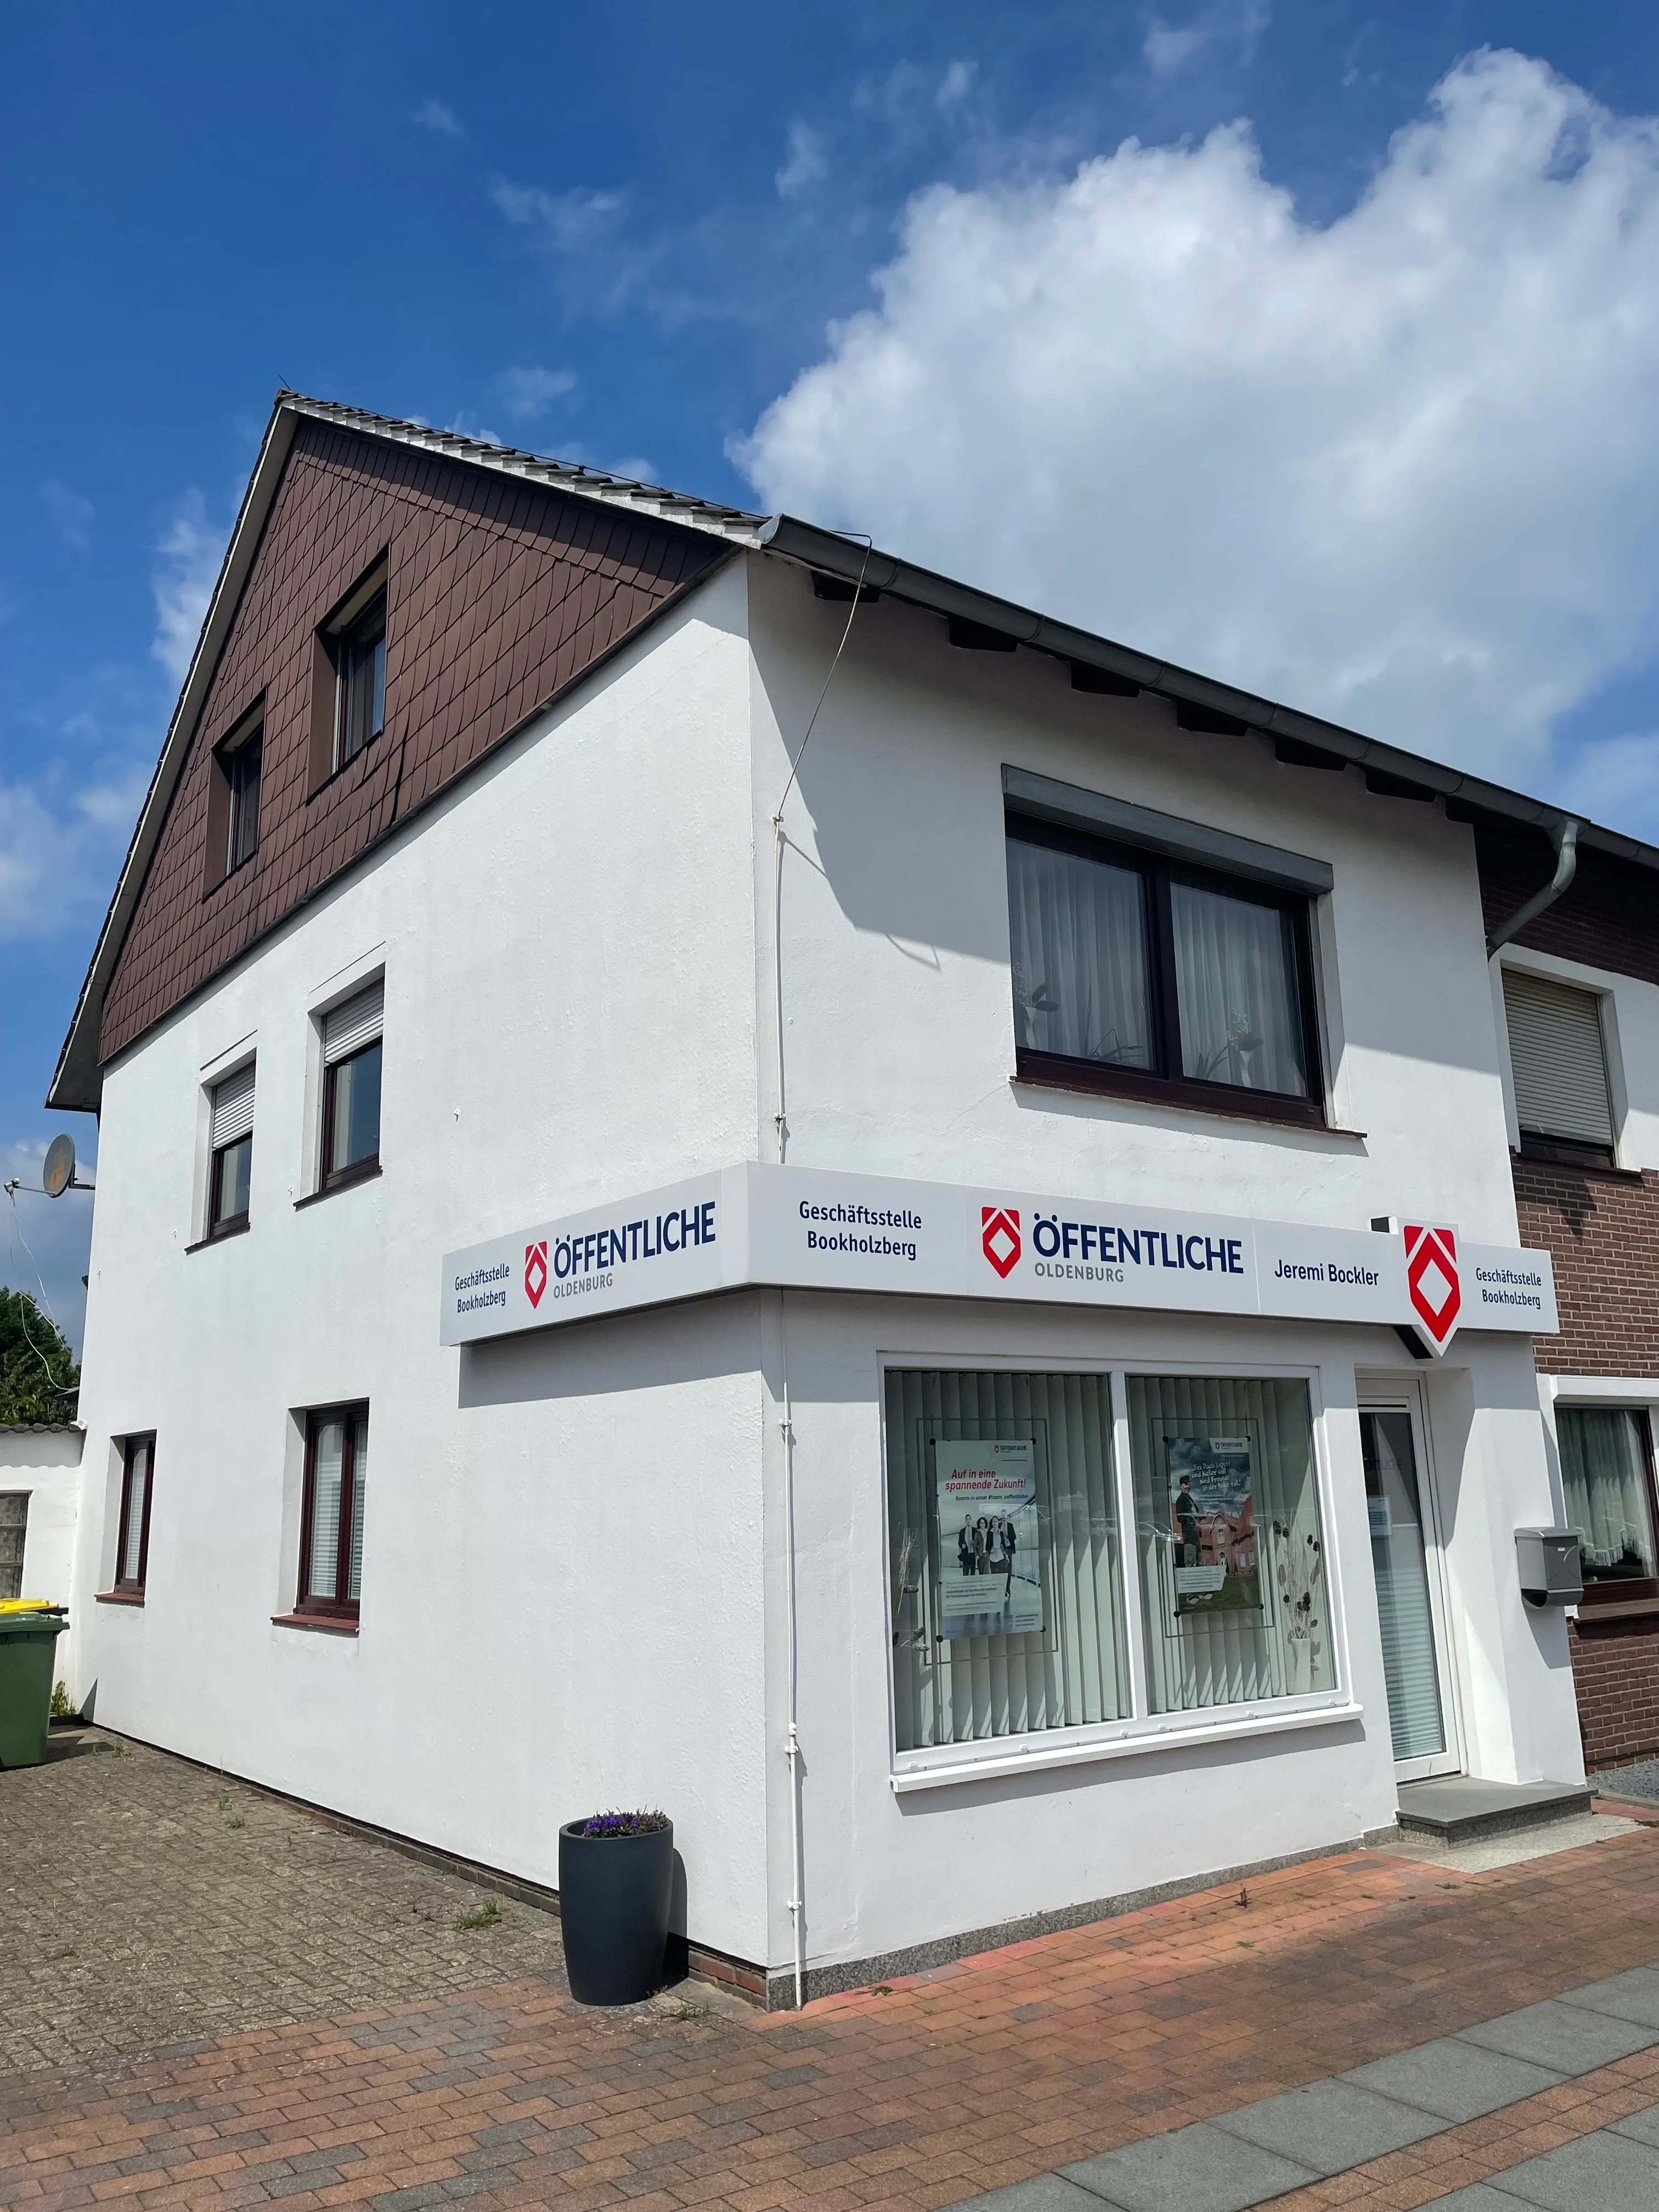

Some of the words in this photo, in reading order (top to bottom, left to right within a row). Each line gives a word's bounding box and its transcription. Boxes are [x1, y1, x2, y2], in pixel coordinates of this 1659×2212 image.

[799, 1200, 922, 1229] Geschäftsstelle
[554, 1201, 716, 1278] ÖFFENTLICHE
[808, 1231, 916, 1261] Bookholzberg
[1032, 1212, 1244, 1274] ÖFFENTLICHE
[455, 1263, 510, 1291] Geschäftsstelle
[554, 1272, 613, 1299] OLDENBURG
[1034, 1262, 1124, 1283] OLDENBURG
[1274, 1259, 1324, 1282] Jeremi
[1328, 1263, 1379, 1286] Bockler
[1476, 1267, 1542, 1286] Geschäftsstelle
[457, 1290, 506, 1313] Bookholzberg
[1482, 1289, 1541, 1310] Bookholzberg
[945, 1480, 991, 1492] spannende
[994, 1479, 1026, 1488] Zukunft!
[951, 1469, 967, 1479] Auf
[968, 1469, 976, 1479] in
[978, 1468, 996, 1478] eine
